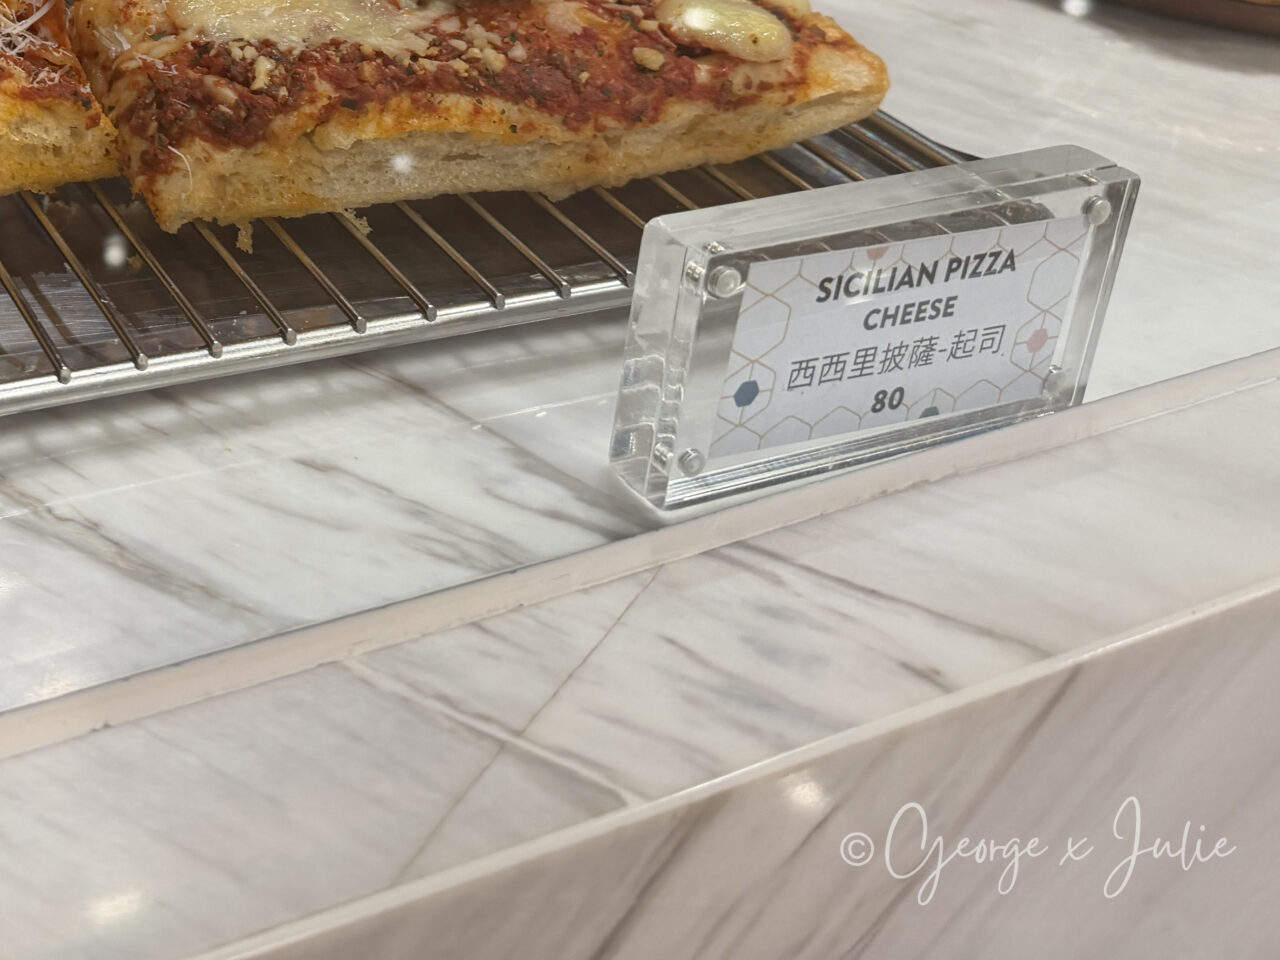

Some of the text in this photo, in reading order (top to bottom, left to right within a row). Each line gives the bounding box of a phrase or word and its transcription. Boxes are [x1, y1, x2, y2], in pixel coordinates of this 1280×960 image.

[815, 248, 1017, 304] SICILIAN PIZZA
[863, 295, 959, 332] CHEESE
[786, 323, 1007, 393] 西西里披薩-起司
[870, 386, 906, 414] 80
